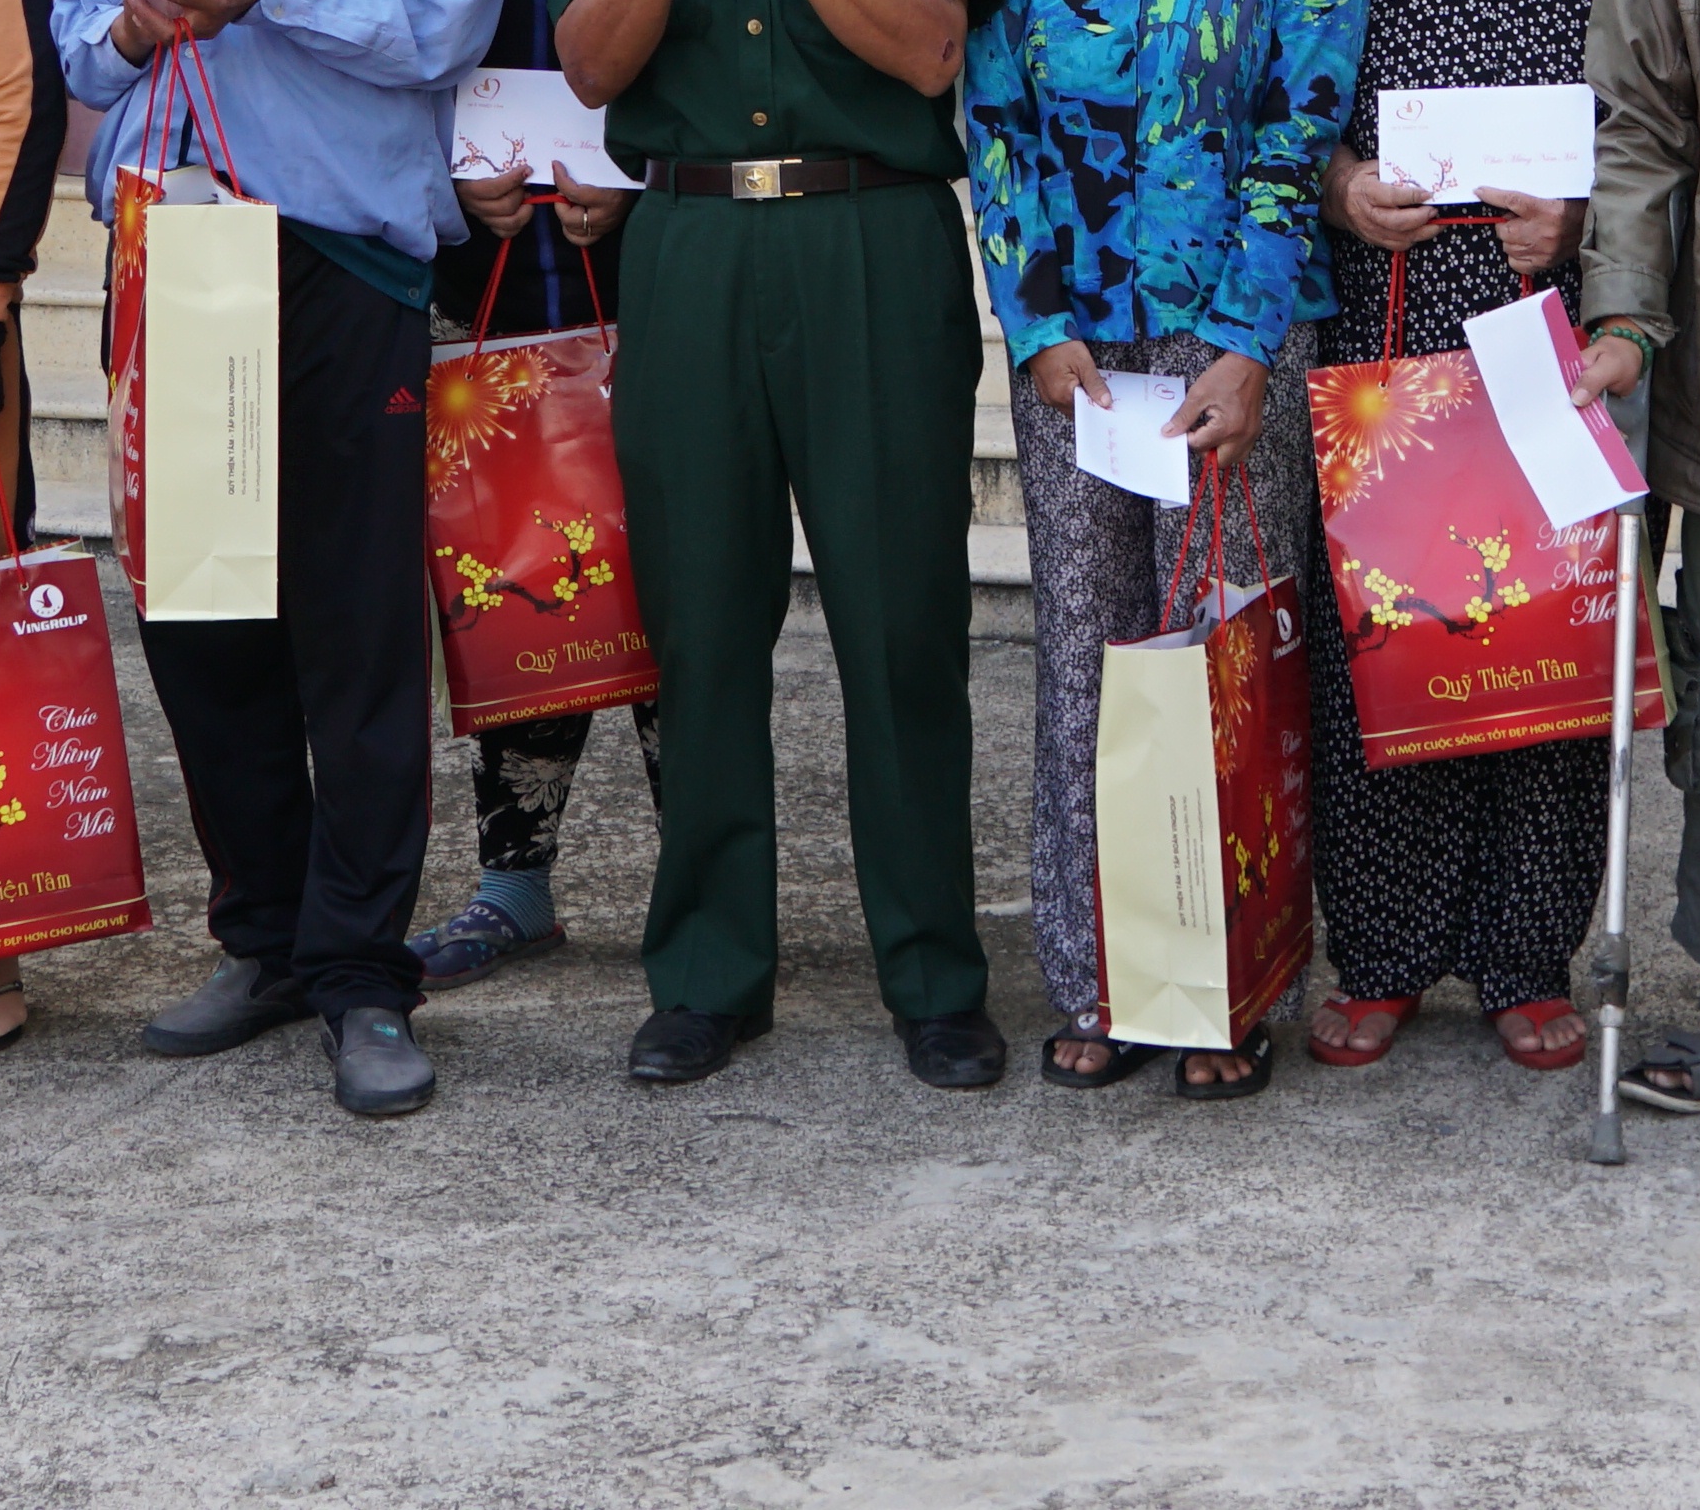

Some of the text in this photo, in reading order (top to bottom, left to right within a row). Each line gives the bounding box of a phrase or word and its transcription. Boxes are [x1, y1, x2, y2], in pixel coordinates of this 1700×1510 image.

[1551, 557, 1616, 591] Năm
[12, 614, 88, 636] VINGROUP
[516, 648, 557, 674] Quỹ
[561, 639, 615, 665] Thiện
[1428, 659, 1578, 702] Quỹ Thiện Tâm
[38, 705, 98, 733] Chúc
[30, 737, 104, 773] Mừng
[46, 776, 109, 809] Năm
[63, 811, 116, 840] Mới
[31, 871, 72, 892] Tâm
